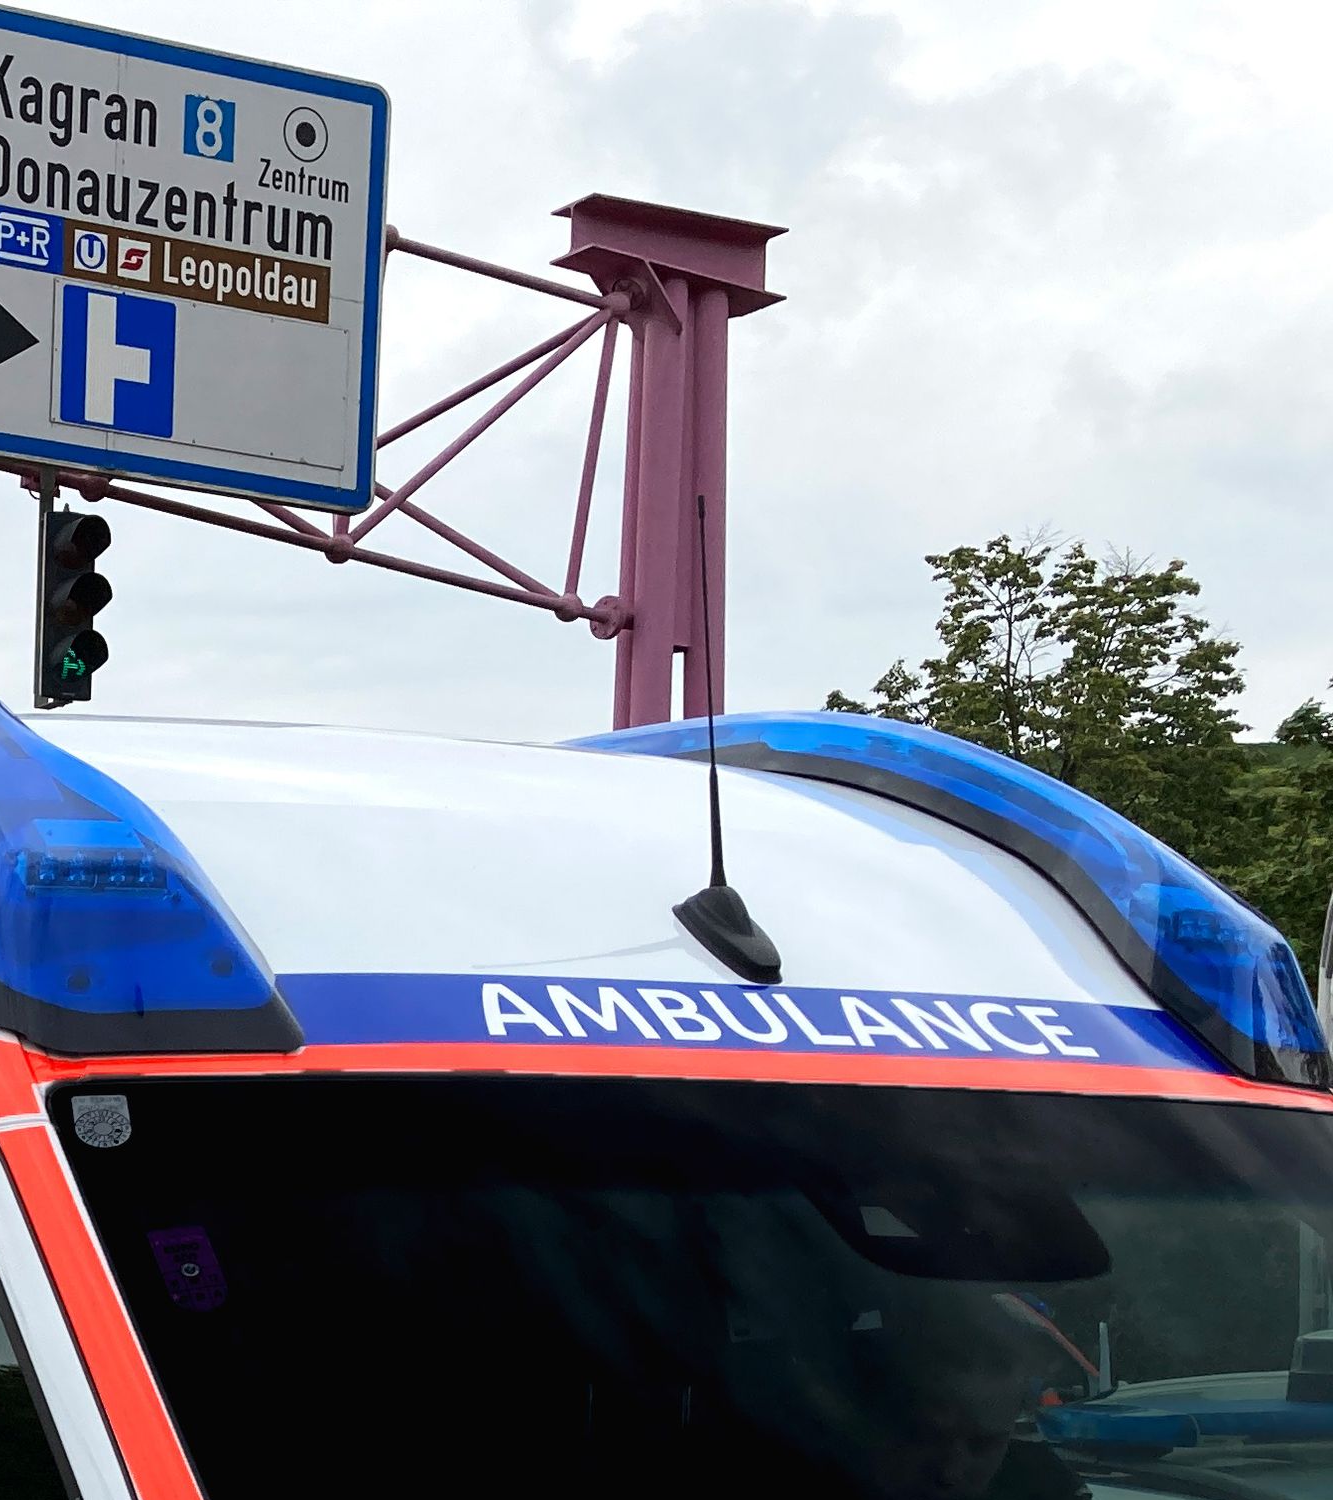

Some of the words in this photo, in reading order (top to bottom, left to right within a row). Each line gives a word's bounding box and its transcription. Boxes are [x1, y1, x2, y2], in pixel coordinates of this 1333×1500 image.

[195, 100, 224, 157] 8
[257, 158, 349, 204] Zentrum
[163, 242, 318, 309] Leopoldau
[482, 983, 1100, 1058] AMBULANCE
